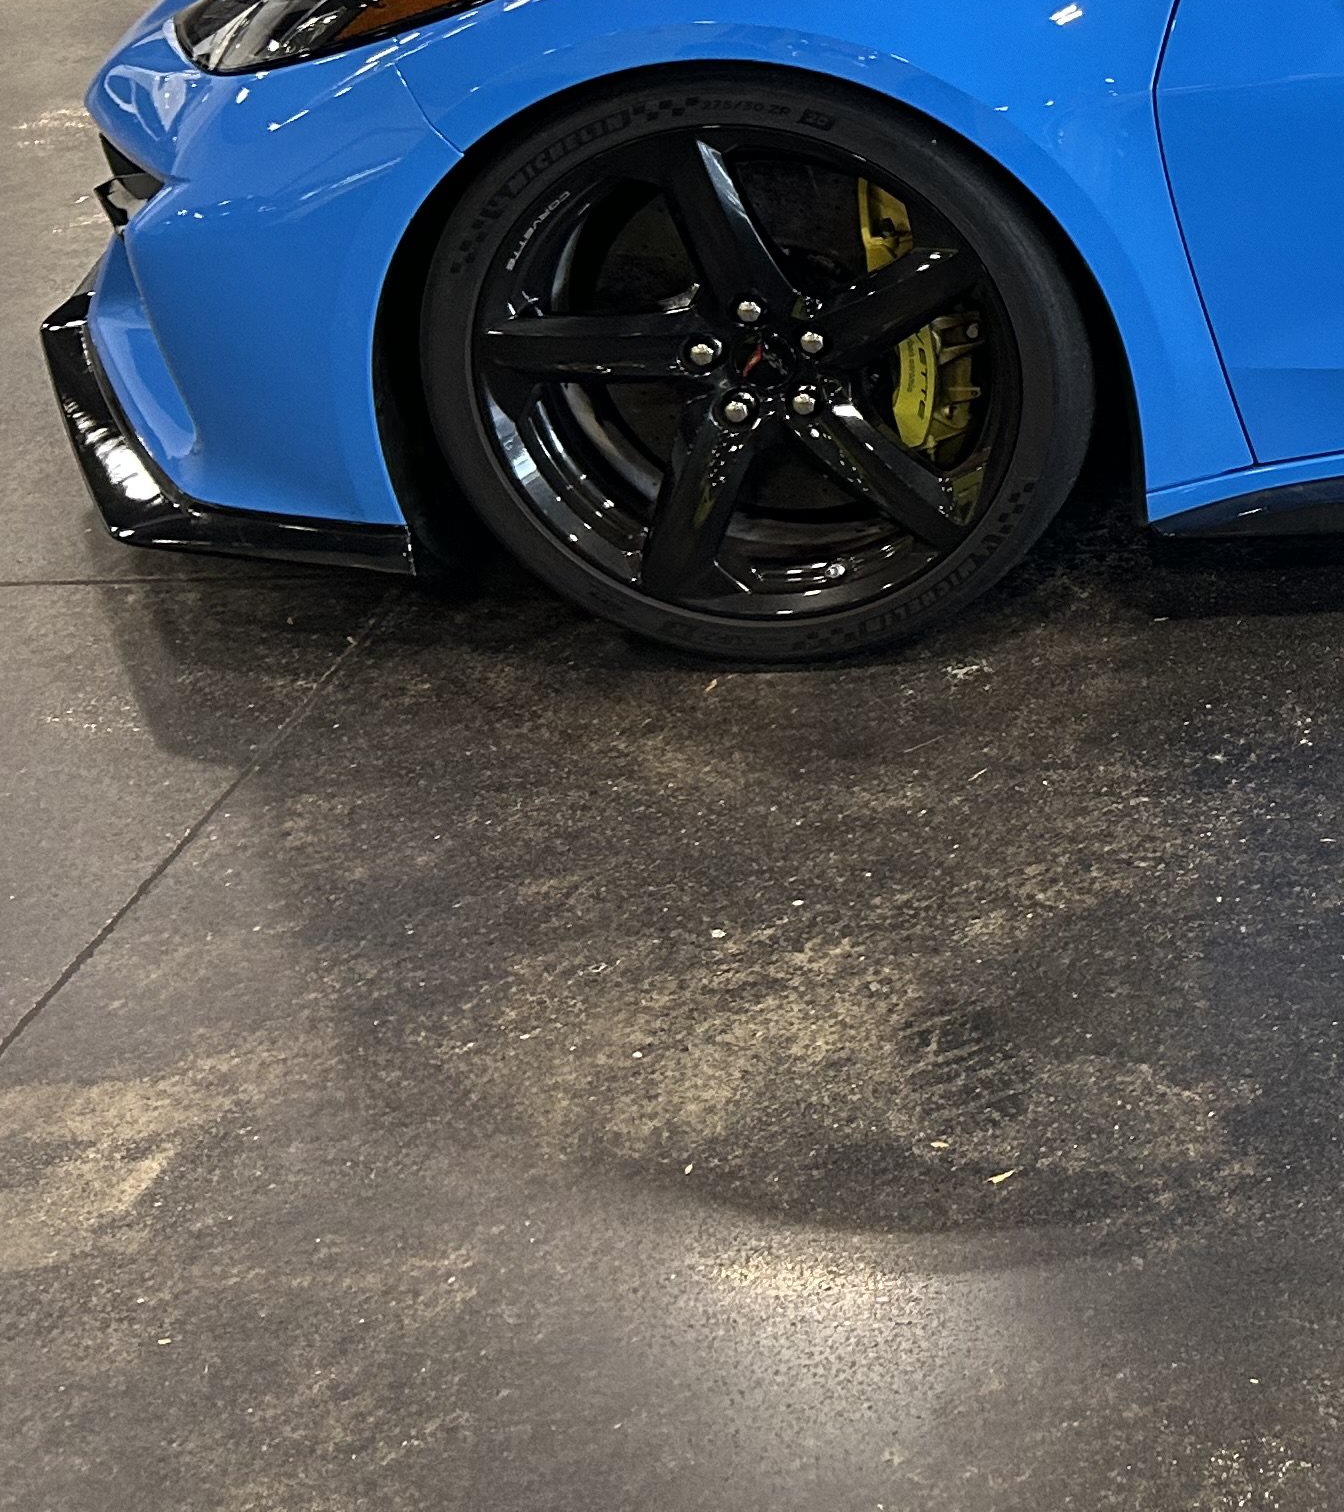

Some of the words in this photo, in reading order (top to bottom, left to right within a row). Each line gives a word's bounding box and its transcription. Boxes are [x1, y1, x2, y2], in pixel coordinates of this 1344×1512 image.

[701, 99, 764, 113] 275/30
[767, 103, 792, 116] ZR
[507, 110, 630, 192] MICHELIN
[505, 189, 571, 273] CORVETTE
[861, 555, 980, 637] MICHELIN
